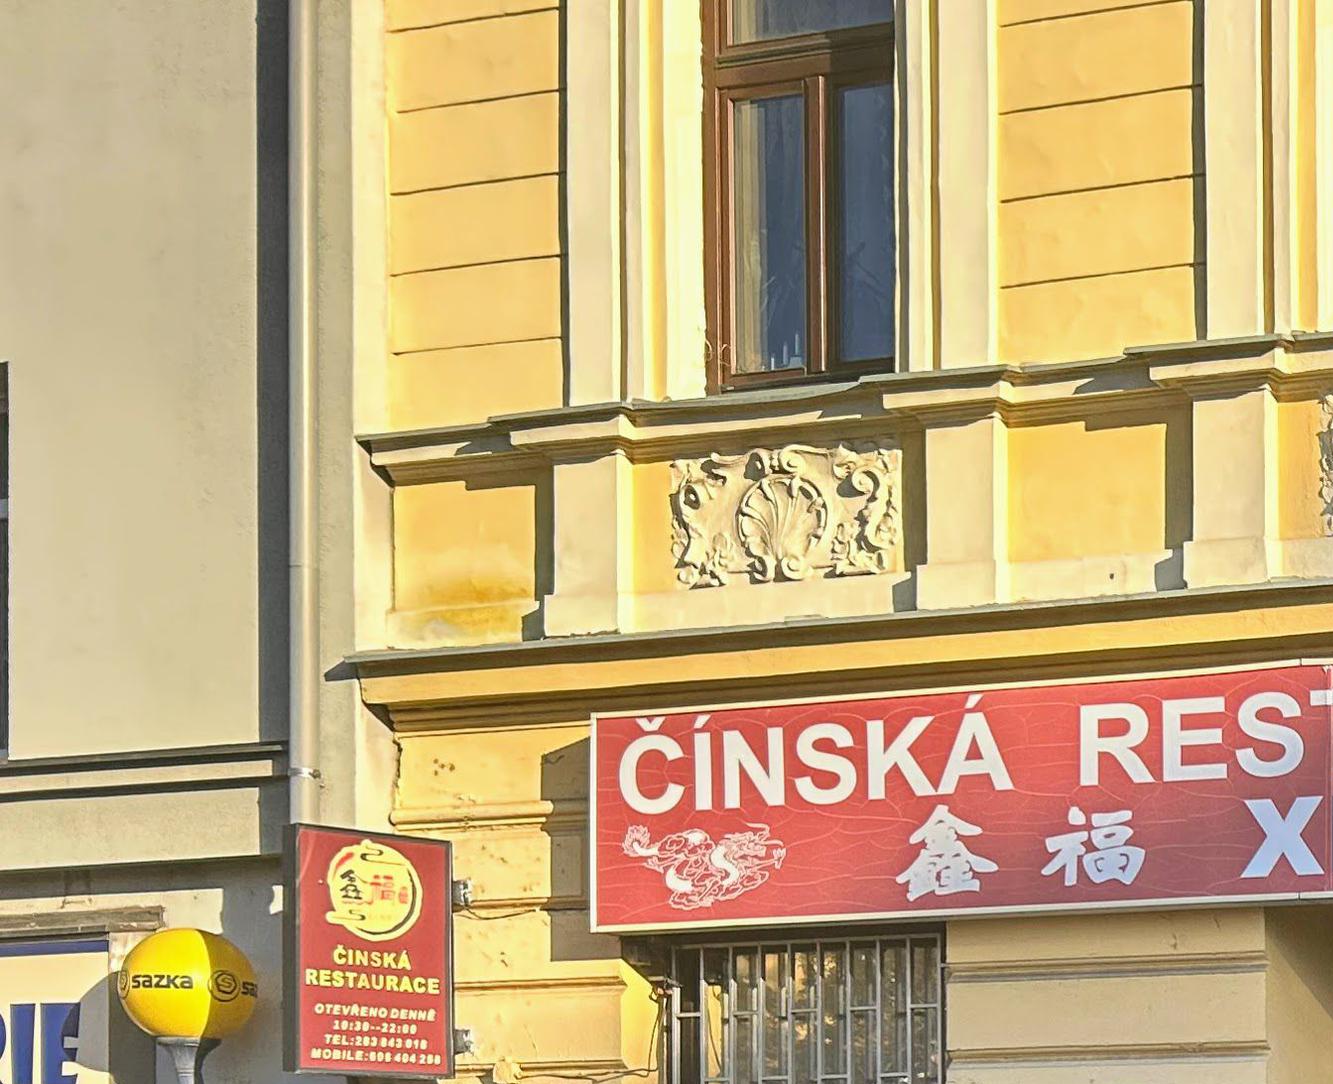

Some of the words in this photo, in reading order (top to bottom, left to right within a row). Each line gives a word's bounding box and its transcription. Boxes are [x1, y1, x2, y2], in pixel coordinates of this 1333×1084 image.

[618, 694, 1012, 814] ČÍNSKÁ
[305, 968, 440, 995] RESTAURACE
[314, 1003, 388, 1019] OTEVŘENO
[390, 1008, 437, 1021] DENNĚ
